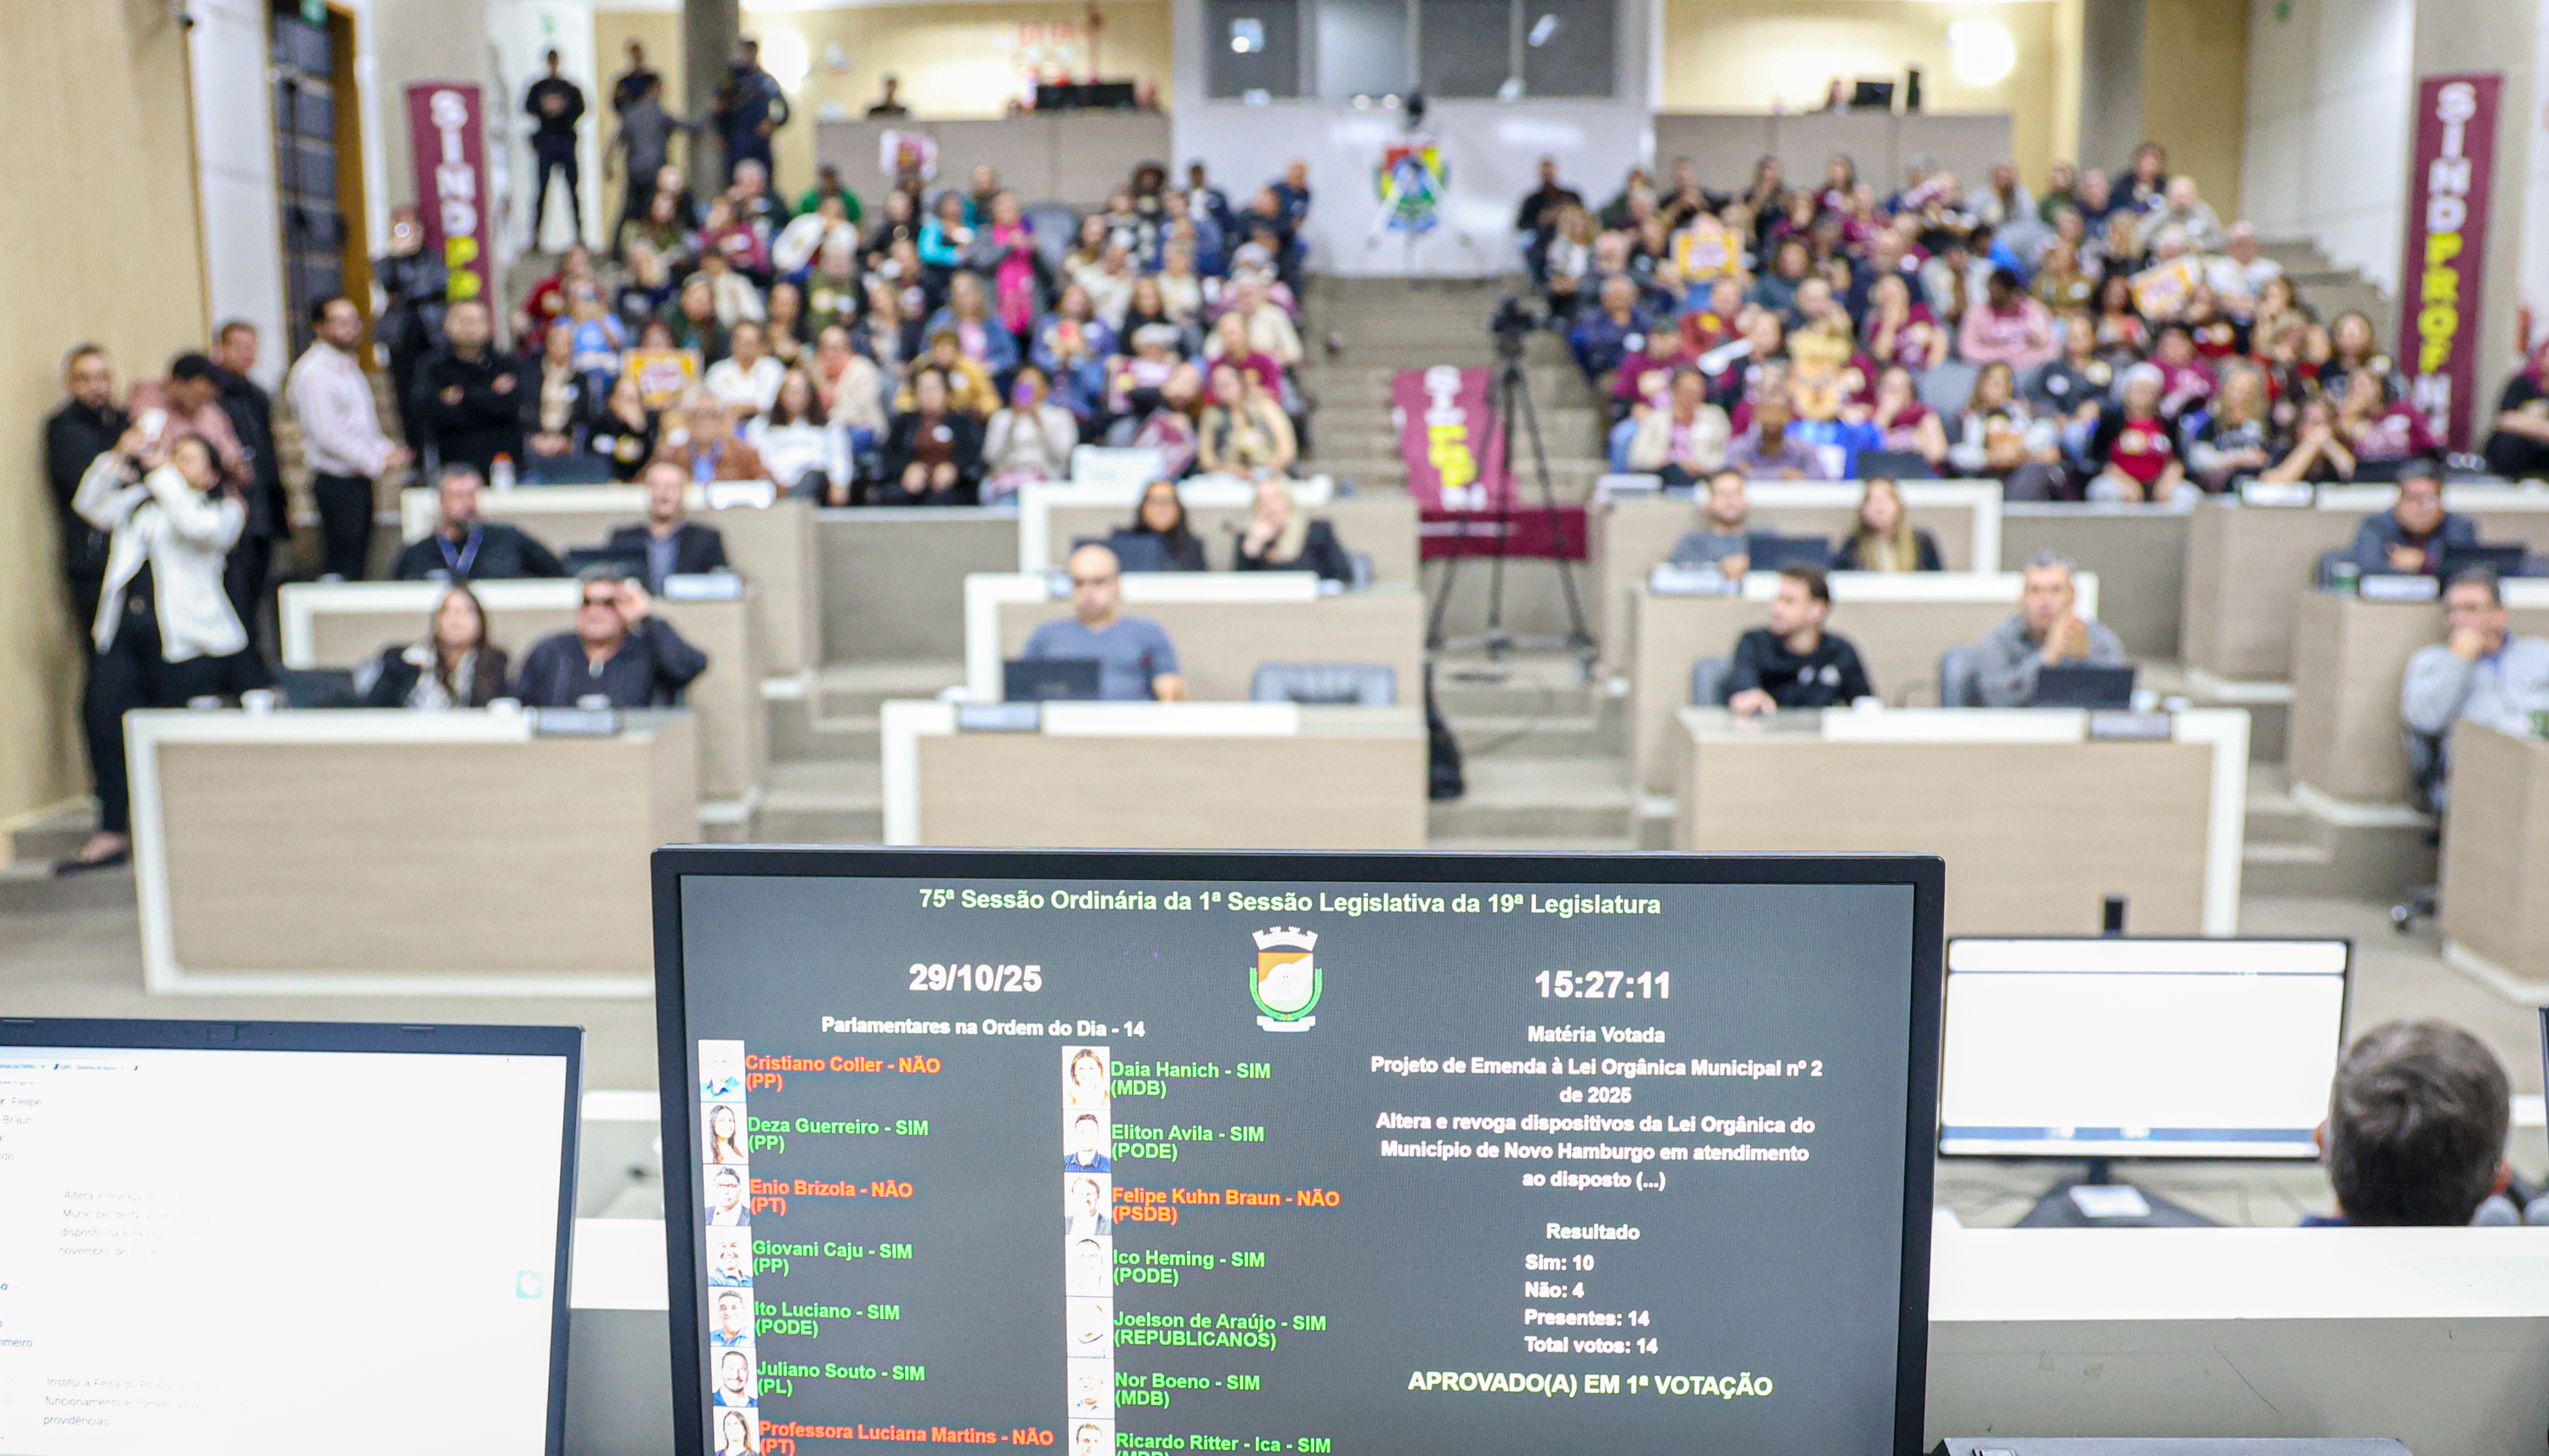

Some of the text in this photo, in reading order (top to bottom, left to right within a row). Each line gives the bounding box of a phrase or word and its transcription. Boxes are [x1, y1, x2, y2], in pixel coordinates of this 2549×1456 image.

[962, 889, 1044, 908] Sessão
[1051, 890, 1156, 909] Ordinária
[1164, 891, 1191, 910] da
[1228, 892, 1312, 911] Sessão
[1320, 893, 1444, 917] Legislativa
[1452, 894, 1479, 912] da
[1532, 894, 1660, 917] Legislatura
[909, 964, 1042, 991] 29/10/25
[1535, 971, 1669, 998] 15:27:11
[822, 1017, 950, 1034] Parlamentares
[956, 1023, 977, 1034] na
[983, 1019, 1043, 1036] Ordem
[1048, 1020, 1072, 1036] do
[1077, 1020, 1106, 1036] Dia
[1124, 1021, 1145, 1036] 14
[1529, 1025, 1664, 1042] Matéria Votada
[746, 1054, 826, 1071] Cristiano
[830, 1056, 884, 1072] Coller
[898, 1055, 941, 1073] NÃO
[1112, 1062, 1150, 1076] Daia
[1156, 1062, 1218, 1077] Hanich
[1237, 1063, 1269, 1078] SIM
[1371, 1056, 1438, 1076] Projeto
[1443, 1057, 1466, 1073] de
[1472, 1058, 1546, 1074] Emenda
[1551, 1057, 1563, 1074] à
[1568, 1058, 1596, 1074] Lei
[1602, 1058, 1686, 1078] Orgânica
[1692, 1059, 1781, 1079] Municipal
[1811, 1060, 1823, 1076] 2
[746, 1072, 783, 1092] (PP)
[1111, 1079, 1166, 1099] (MDB)
[1560, 1086, 1631, 1103] de 2025
[748, 1118, 790, 1134] Deza
[795, 1118, 879, 1134] Guerreiro
[896, 1120, 928, 1135] SIM
[1111, 1125, 1163, 1140] Eliton
[1168, 1126, 1212, 1140] Avila
[1230, 1126, 1263, 1142] SIM
[1376, 1113, 1815, 1136] Altera e revoga dispositivos da Lei Orgânica do
[749, 1134, 785, 1154] (PP)
[1111, 1142, 1178, 1162] (PODE)
[1382, 1140, 1809, 1163] Município de Novo Hamburgo em atendimento
[749, 1180, 788, 1196] Enio
[794, 1180, 856, 1196] Brizola
[871, 1180, 913, 1198] NÃO
[1523, 1171, 1665, 1191] ao disposto (...)
[750, 1196, 787, 1216] (PT)
[1112, 1188, 1166, 1208] Felipe
[1172, 1188, 1221, 1204] Kuhn
[1225, 1189, 1281, 1205] Braun
[1297, 1188, 1341, 1206] NÃO
[1111, 1205, 1178, 1225] (PSDB)
[1547, 1223, 1640, 1239] Resultado
[752, 1240, 818, 1258] Giovani
[824, 1242, 862, 1261] Caju
[880, 1244, 912, 1259] SIM
[1113, 1250, 1139, 1267] Ico
[1146, 1250, 1213, 1269] Heming
[1231, 1252, 1264, 1267] SIM
[753, 1257, 789, 1276] (PP)
[1525, 1254, 1594, 1271] Sim: 10
[1113, 1267, 1178, 1286] (PODE)
[1525, 1282, 1584, 1298] Não: 4
[755, 1301, 777, 1318] Ito
[783, 1302, 851, 1318] Luciano
[868, 1305, 899, 1319] SIM
[1525, 1309, 1649, 1326] Presentes: 14
[755, 1318, 819, 1338] (PODE)
[1114, 1312, 1184, 1329] Joelson
[1190, 1313, 1211, 1328] de
[1213, 1313, 1275, 1335] Araújo
[1293, 1316, 1325, 1330] SIM
[1114, 1329, 1276, 1350] (REPUBLICANOS)
[1524, 1336, 1658, 1354] Total votos: 14
[757, 1362, 820, 1379] Juliano
[825, 1363, 876, 1379] Souto
[893, 1366, 924, 1380] SIM
[757, 1378, 793, 1397] (PL)
[1115, 1373, 1147, 1389] Nor
[1153, 1373, 1210, 1389] Boeno
[1227, 1375, 1259, 1390] SIM
[1408, 1371, 1577, 1397] APROVADO(A)
[1585, 1374, 1619, 1393] EM
[1654, 1372, 1772, 1399] VOTAÇÃO
[1115, 1389, 1170, 1409] (MDB)
[760, 1420, 852, 1440] Professora
[857, 1424, 927, 1441] Luciana
[931, 1427, 997, 1444] Martins
[1012, 1427, 1054, 1446] NÃO
[1116, 1432, 1184, 1450] Ricardo
[1190, 1435, 1239, 1450] Ritter
[1256, 1436, 1280, 1452] Ica
[1298, 1438, 1331, 1453] SIM
[760, 1437, 797, 1456] (PT)
